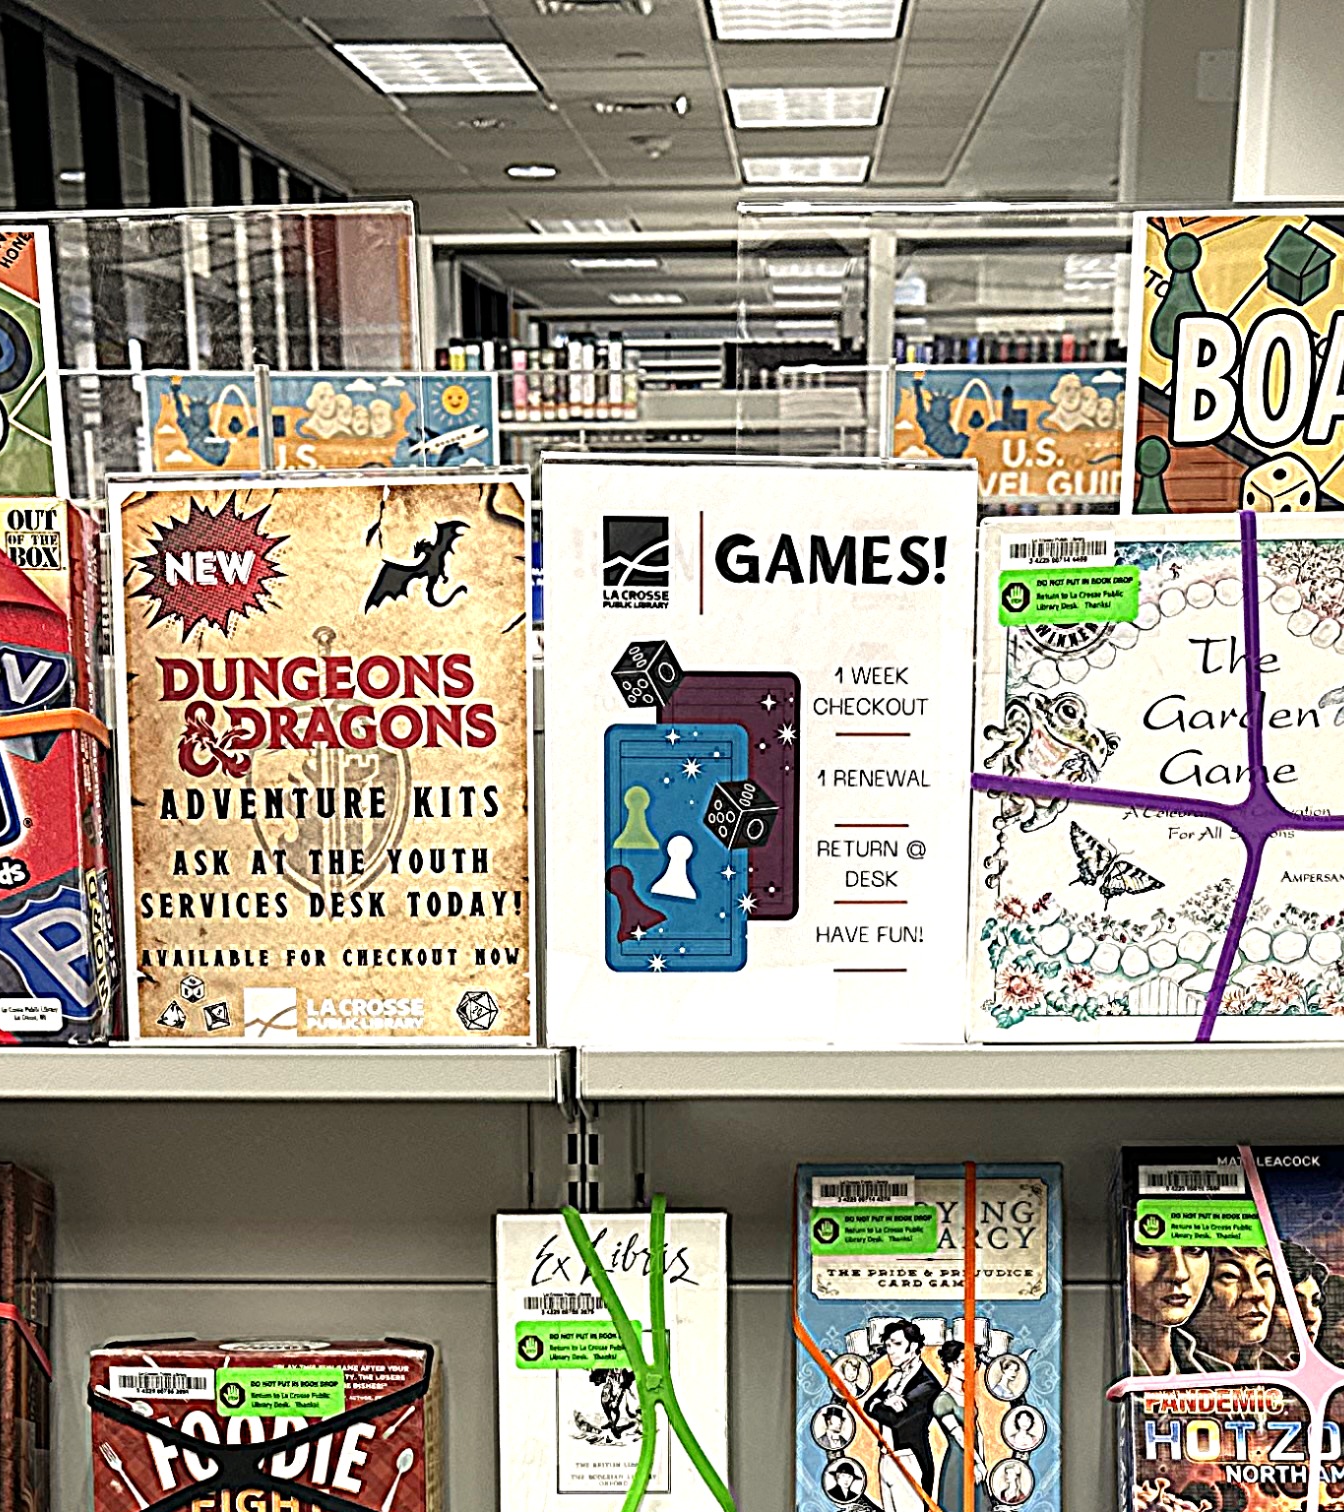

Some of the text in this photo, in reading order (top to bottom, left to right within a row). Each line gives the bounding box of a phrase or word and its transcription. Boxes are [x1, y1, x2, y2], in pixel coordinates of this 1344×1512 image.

[1001, 439, 1065, 470] U.S.
[8, 508, 57, 531] OUT
[7, 532, 57, 547] OF THE
[9, 546, 59, 569] BOX
[165, 550, 254, 586] NEW
[715, 533, 947, 585] GAMES!
[603, 591, 668, 600] LA CROSSE
[603, 601, 668, 609] PUBLIC LIBRARY
[1188, 636, 1281, 675] The
[156, 655, 474, 701] DUNGEONS
[835, 668, 908, 684] 1 WEEK
[813, 698, 928, 716] CHECKOUT
[230, 704, 498, 749] DRAGONS
[818, 769, 930, 787] 1 RENEWAL
[1160, 750, 1299, 785] Game
[160, 787, 499, 820] ADVENTURE KITS
[818, 840, 926, 858] RETURN @
[173, 849, 489, 876] ASK AT THE YOUTH
[845, 870, 897, 887] DESK
[141, 891, 523, 919] SERVICES DESK TODAY!
[817, 926, 923, 944] HAVE FUN!
[141, 949, 520, 967] AVAILABLE FOR CHECKOUT NOW
[307, 999, 423, 1016] LA CROSSE
[1257, 1155, 1320, 1167] LEACOCK
[1144, 1389, 1284, 1414] PANDEMIC
[150, 1409, 377, 1494] FOODIE
[1145, 1421, 1255, 1461] HOT
[1226, 1466, 1306, 1483] NORTH
